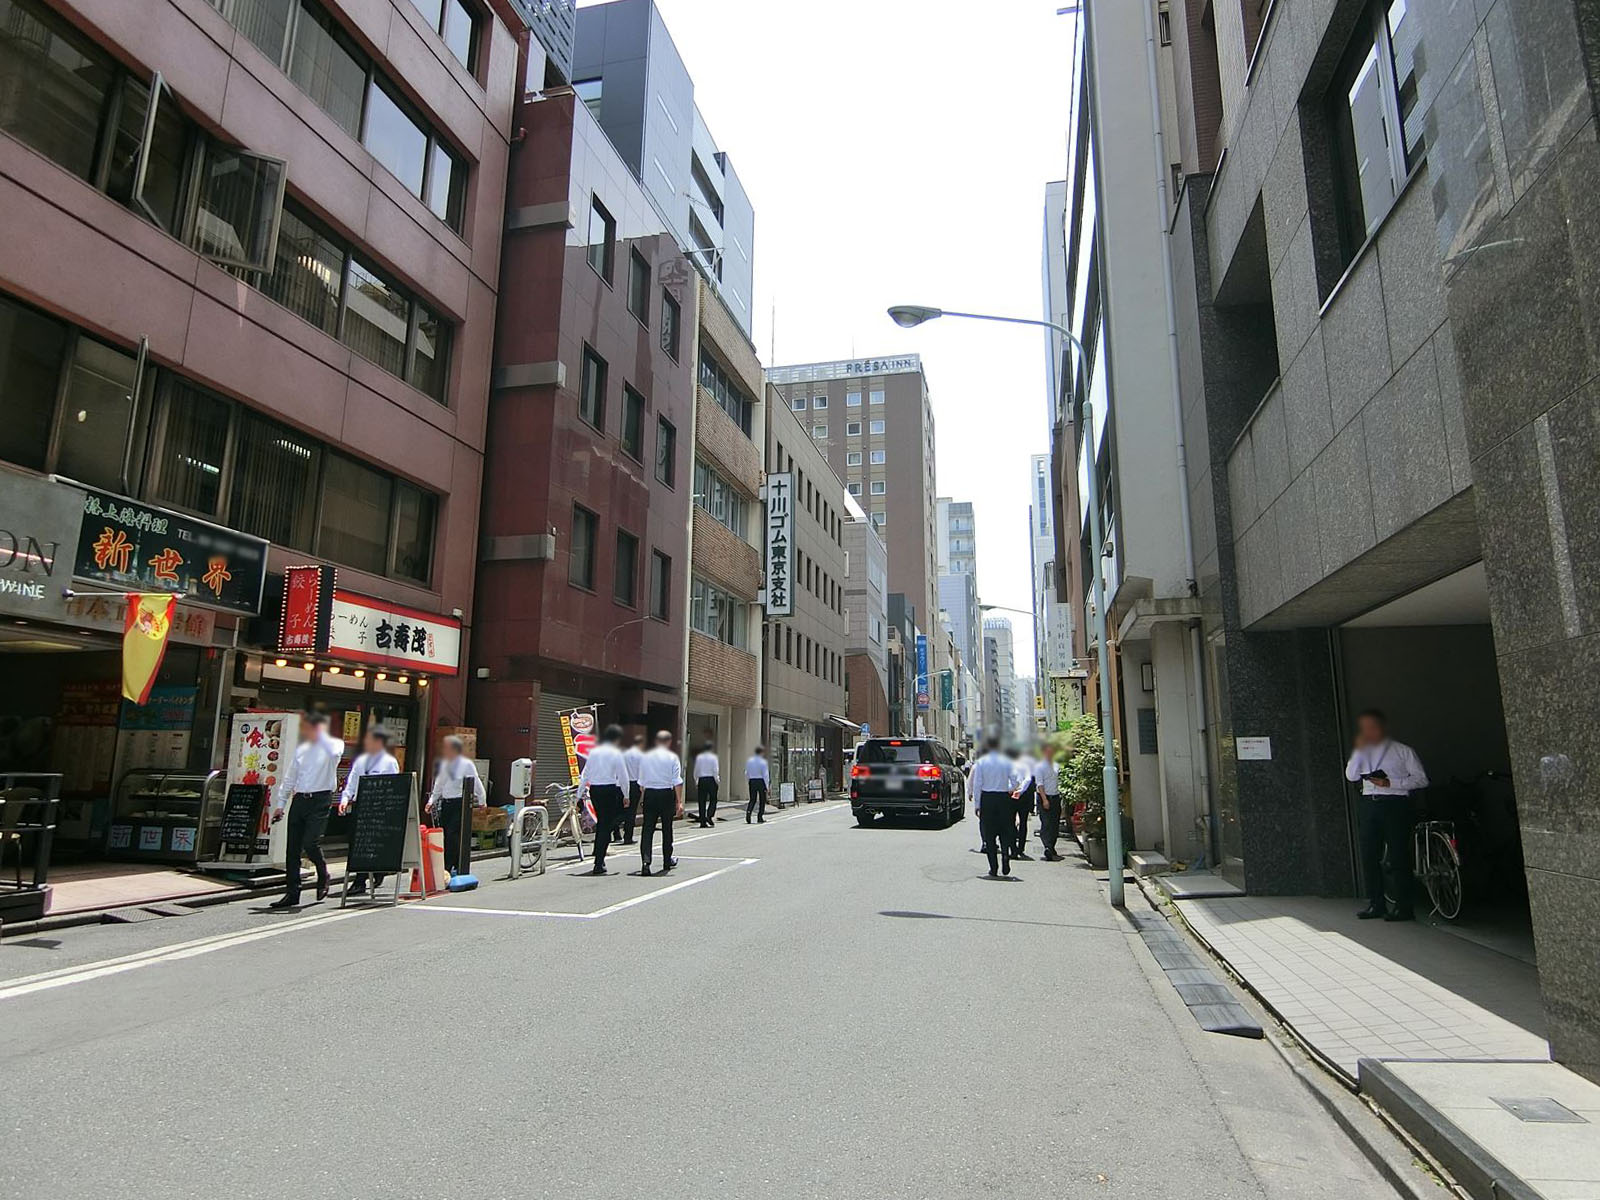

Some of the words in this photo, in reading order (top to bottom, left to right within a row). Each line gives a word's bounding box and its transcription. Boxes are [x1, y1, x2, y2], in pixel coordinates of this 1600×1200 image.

[891, 359, 911, 369] INN
[92, 526, 232, 597] 新世界
[770, 480, 789, 608] 十川ゴム東京支社
